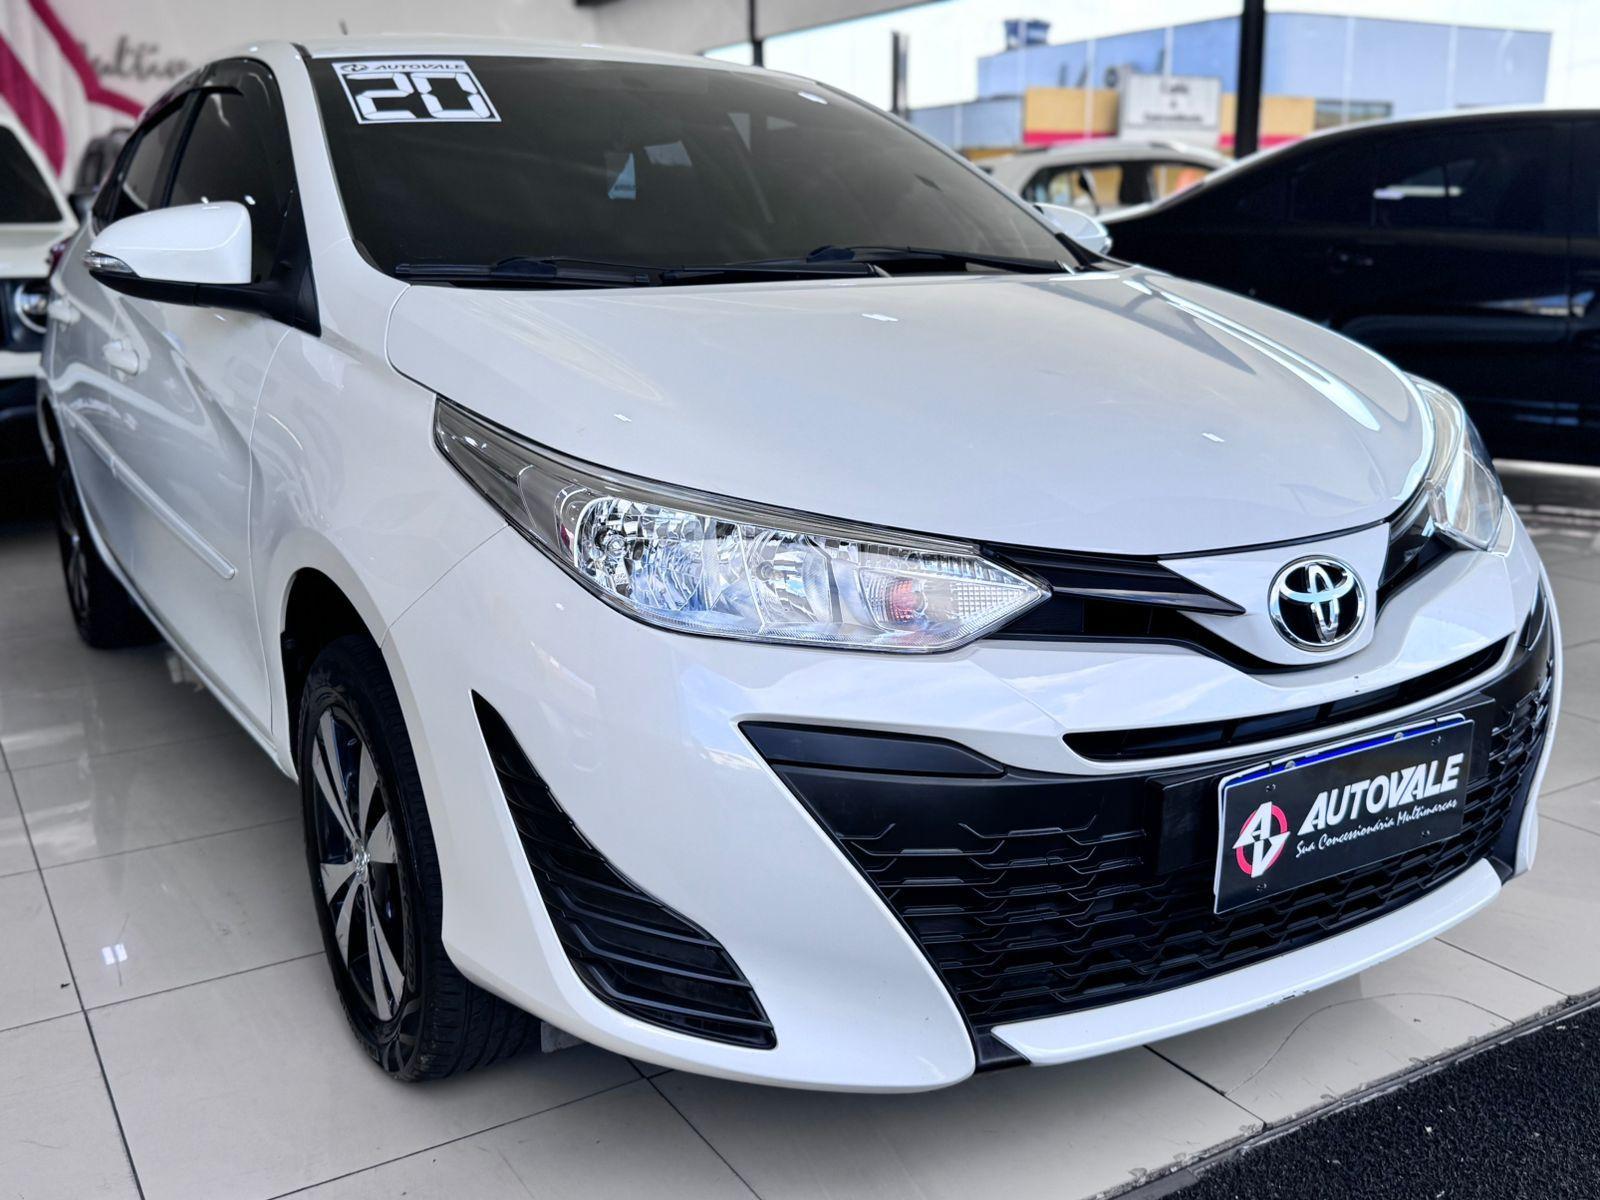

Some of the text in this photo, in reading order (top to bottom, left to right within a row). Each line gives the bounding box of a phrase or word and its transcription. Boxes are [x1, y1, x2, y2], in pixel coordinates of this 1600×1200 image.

[374, 63, 465, 71] AUTOVALE
[346, 72, 491, 120] 20
[1297, 753, 1464, 836] AUTOVALE
[1295, 840, 1316, 858] Sua
[1396, 799, 1457, 827] Multimarcas
